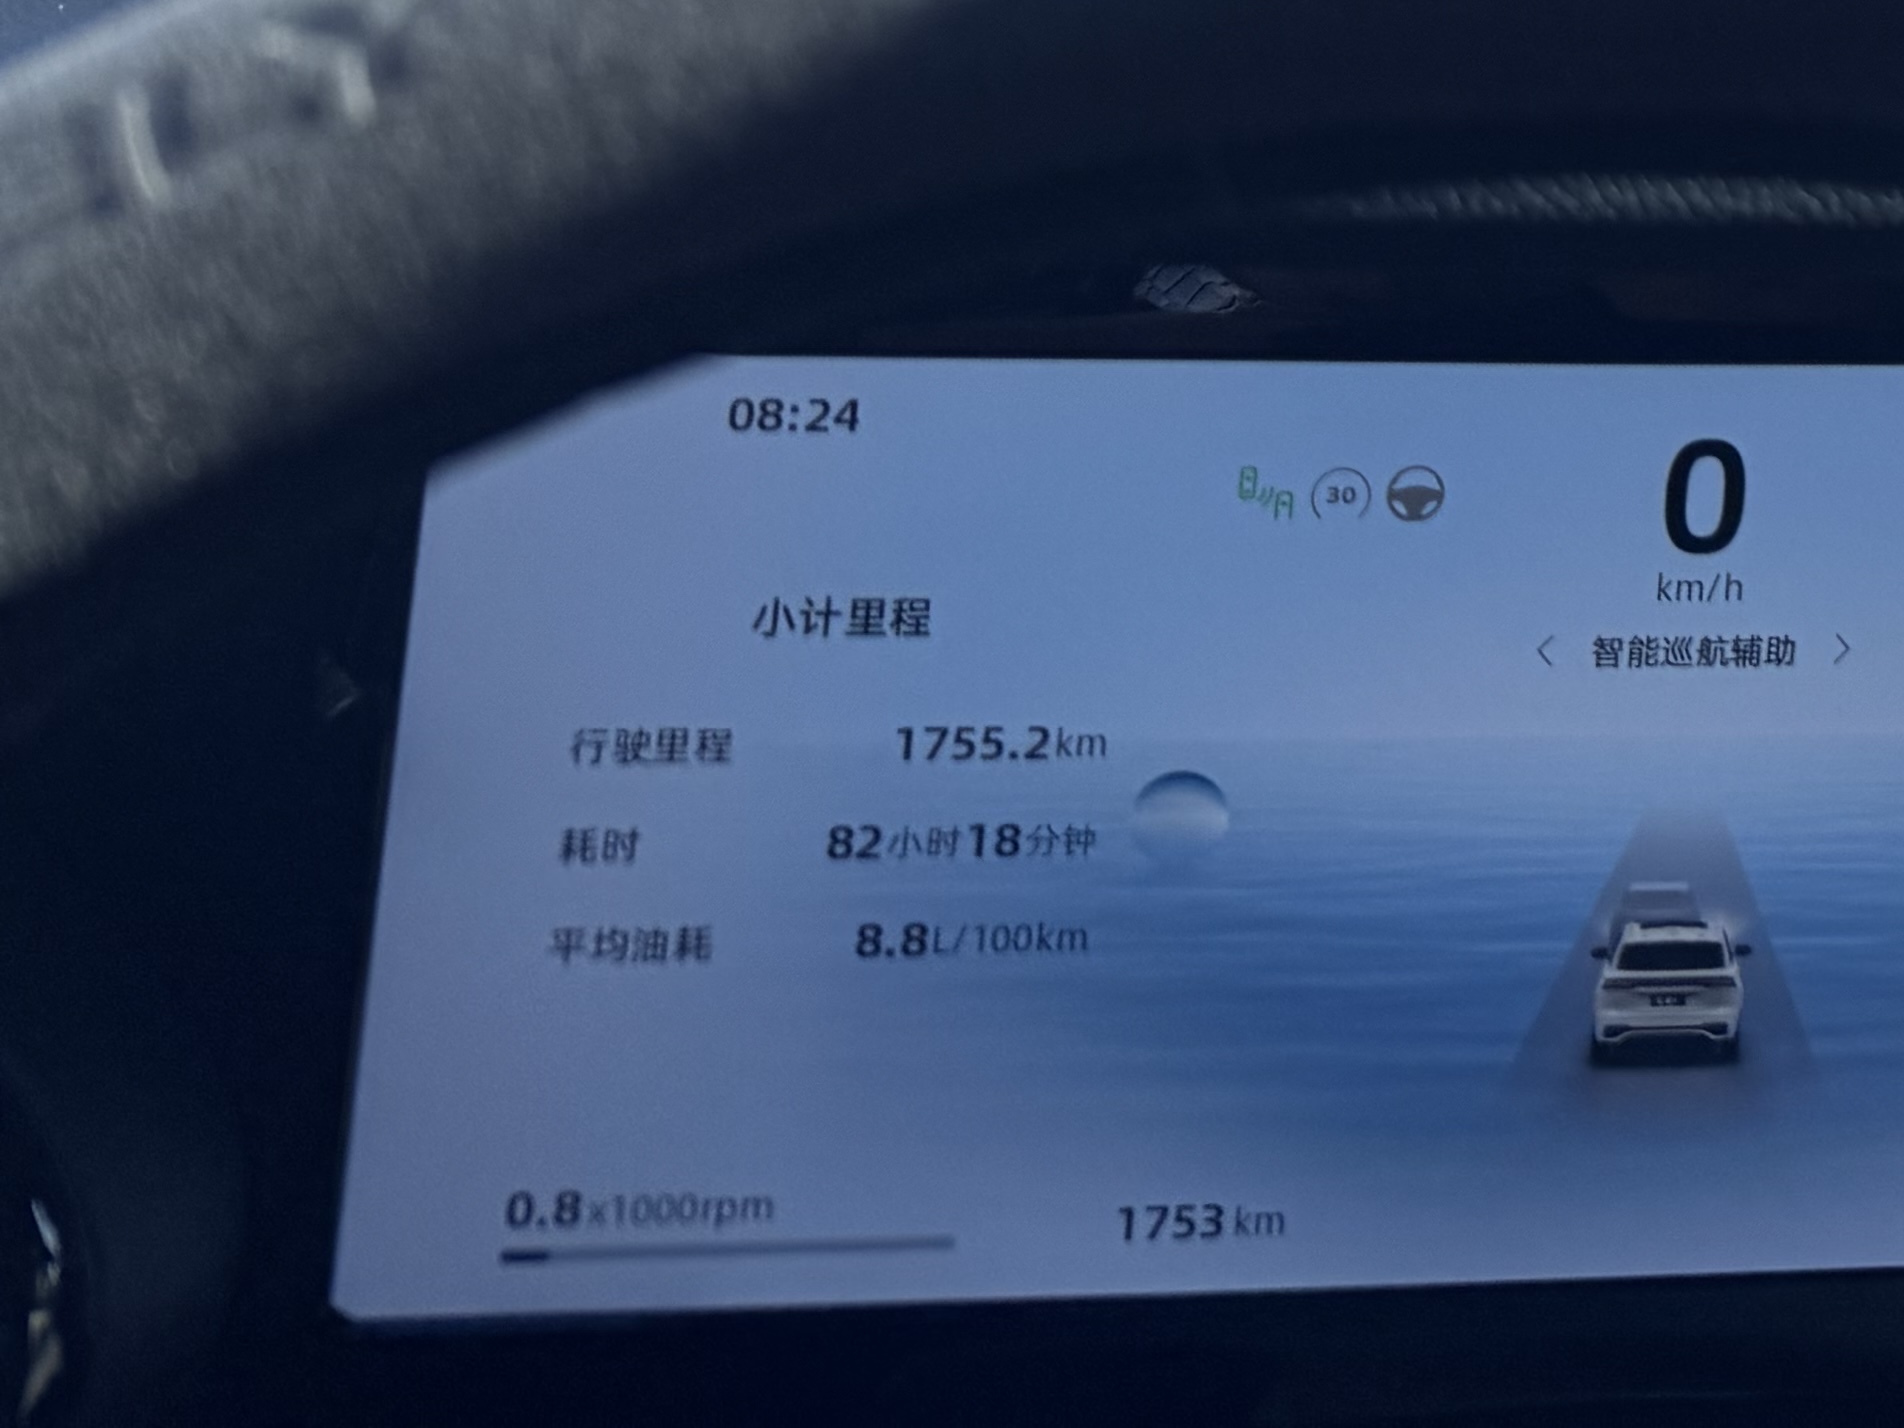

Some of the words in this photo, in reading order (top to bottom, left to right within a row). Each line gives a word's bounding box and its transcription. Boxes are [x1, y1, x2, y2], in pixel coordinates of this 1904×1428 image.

[727, 396, 861, 435] 08:24
[1326, 485, 1358, 507] 30
[1663, 438, 1747, 556] 0
[1655, 571, 1745, 604] km/h
[751, 595, 932, 641] 小计里程
[1592, 633, 1798, 670] 智能巡航辅助
[569, 726, 735, 768] 行驶里程
[558, 826, 641, 867] 耗时
[825, 821, 1099, 862] 82小时18分钟
[551, 924, 714, 965] 平均油耗
